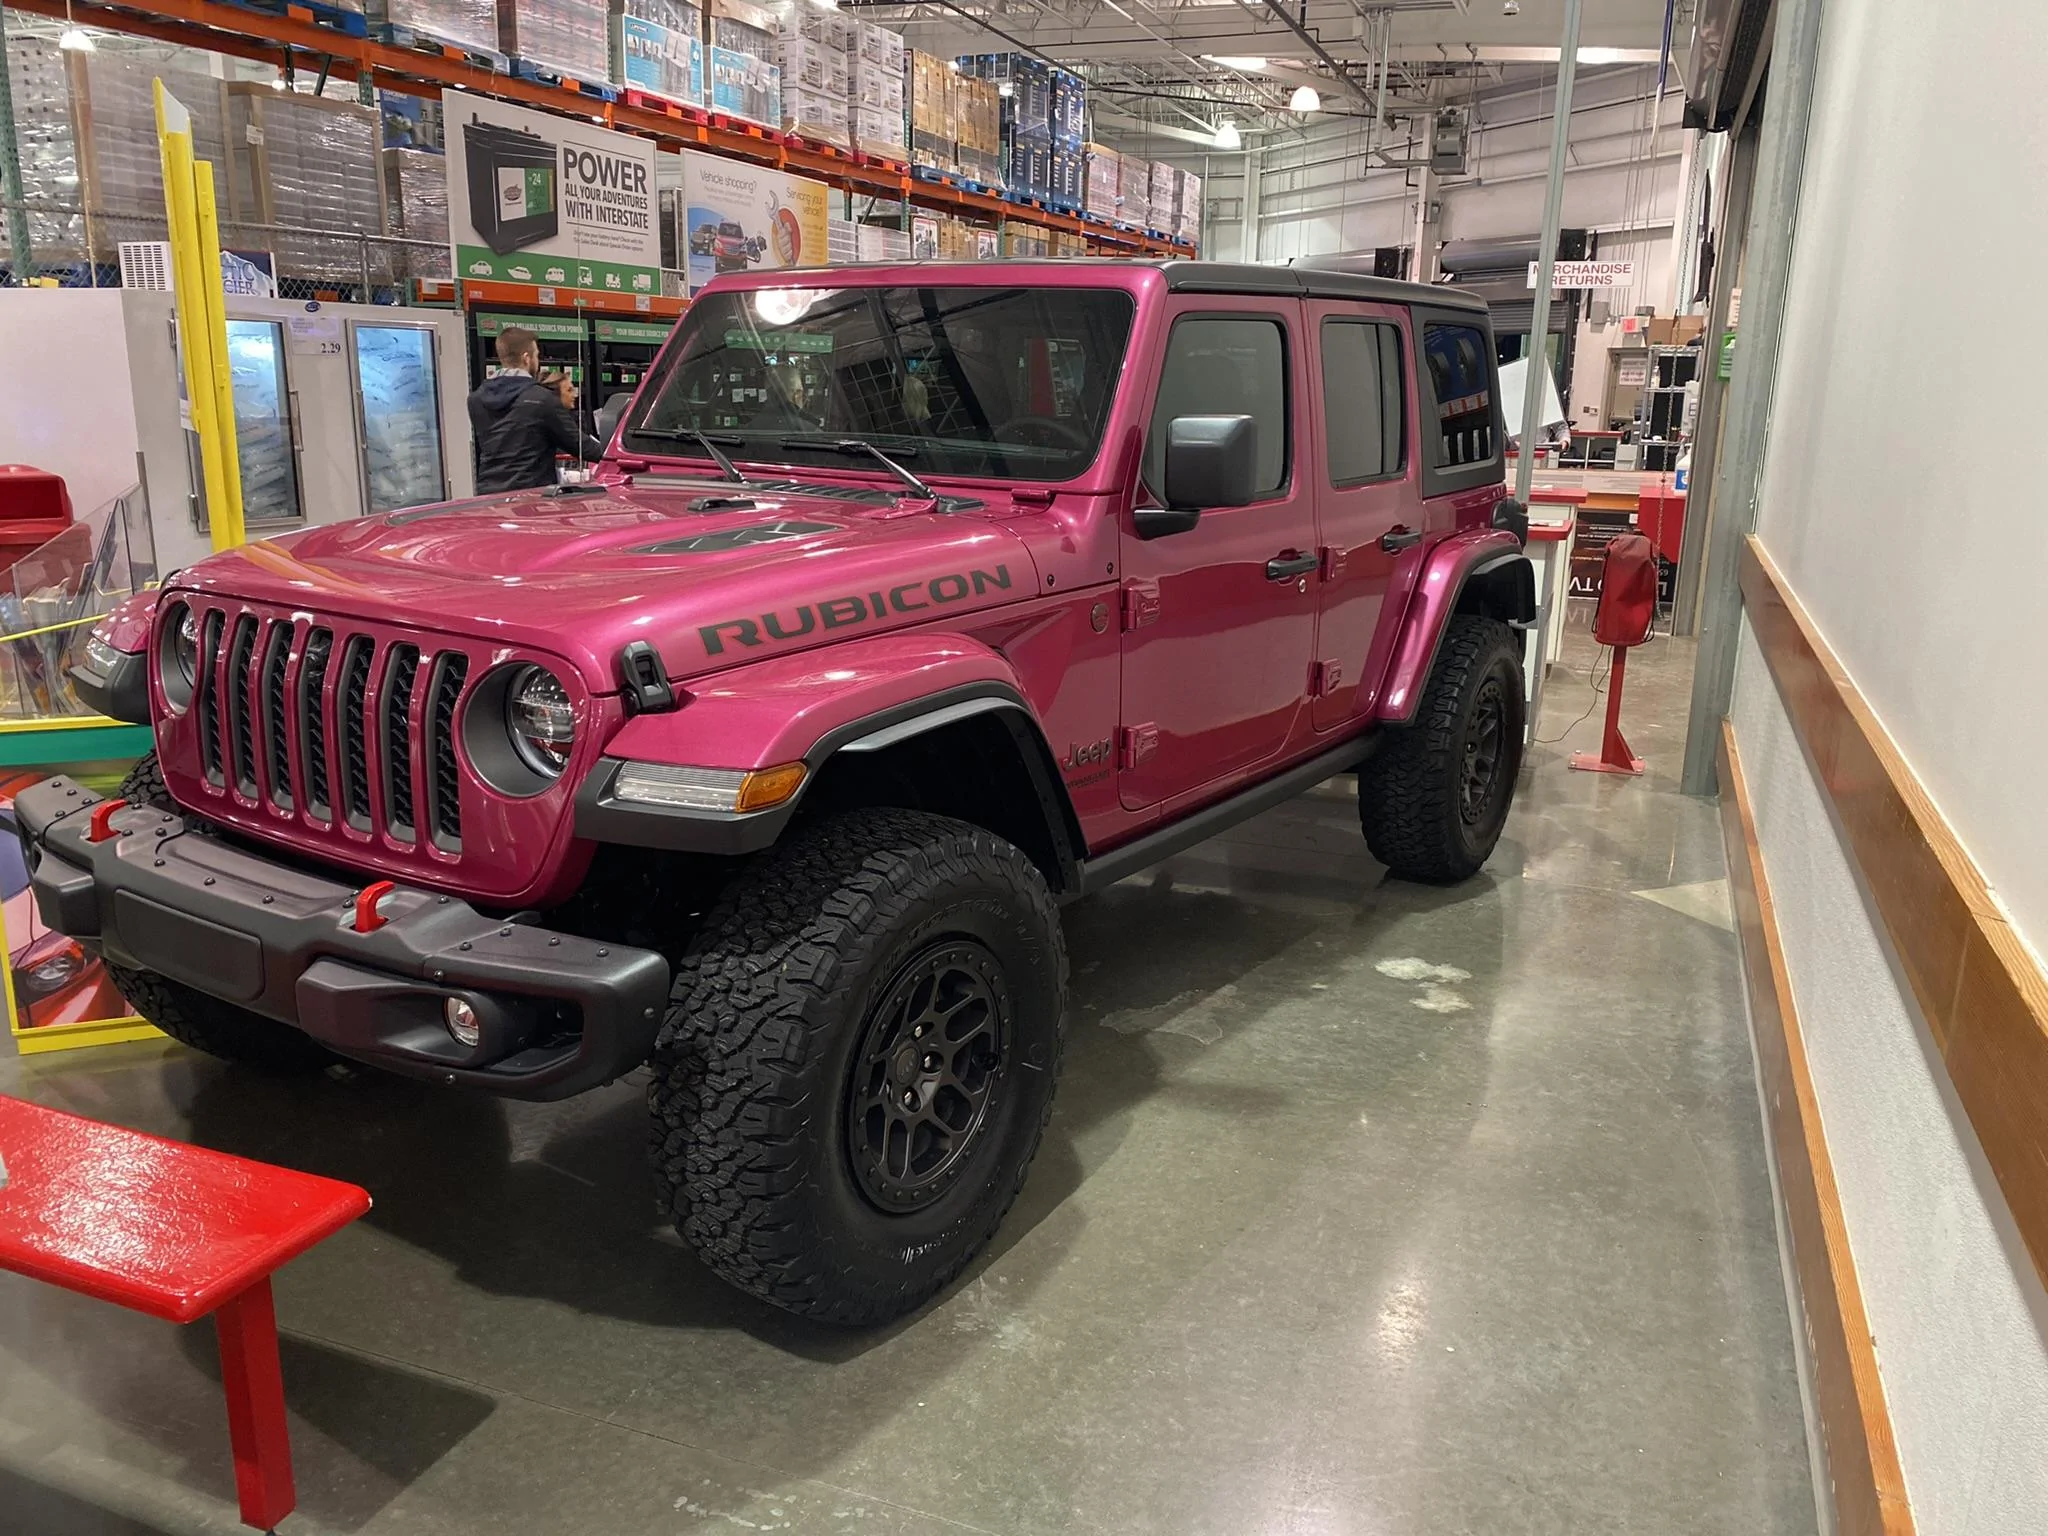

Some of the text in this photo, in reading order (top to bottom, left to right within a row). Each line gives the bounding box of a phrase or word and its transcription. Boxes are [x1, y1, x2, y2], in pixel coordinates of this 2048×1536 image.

[532, 173, 541, 185] 24
[563, 147, 648, 194] POWER
[700, 168, 757, 193] Vehicle shopping?
[565, 183, 578, 197] ALL
[580, 185, 602, 202] YOUR
[602, 190, 648, 210] ADVENTURES
[565, 200, 593, 220] WITH
[596, 204, 649, 229] INTERSTATE
[221, 262, 254, 281] TIC
[1533, 263, 1632, 275] MRCHANDISE
[1552, 275, 1613, 285] RETURNS
[223, 280, 256, 295] CIER
[321, 342, 341, 354] 2.29
[697, 564, 1013, 657] RUBICON
[1061, 737, 1113, 772] Jeep
